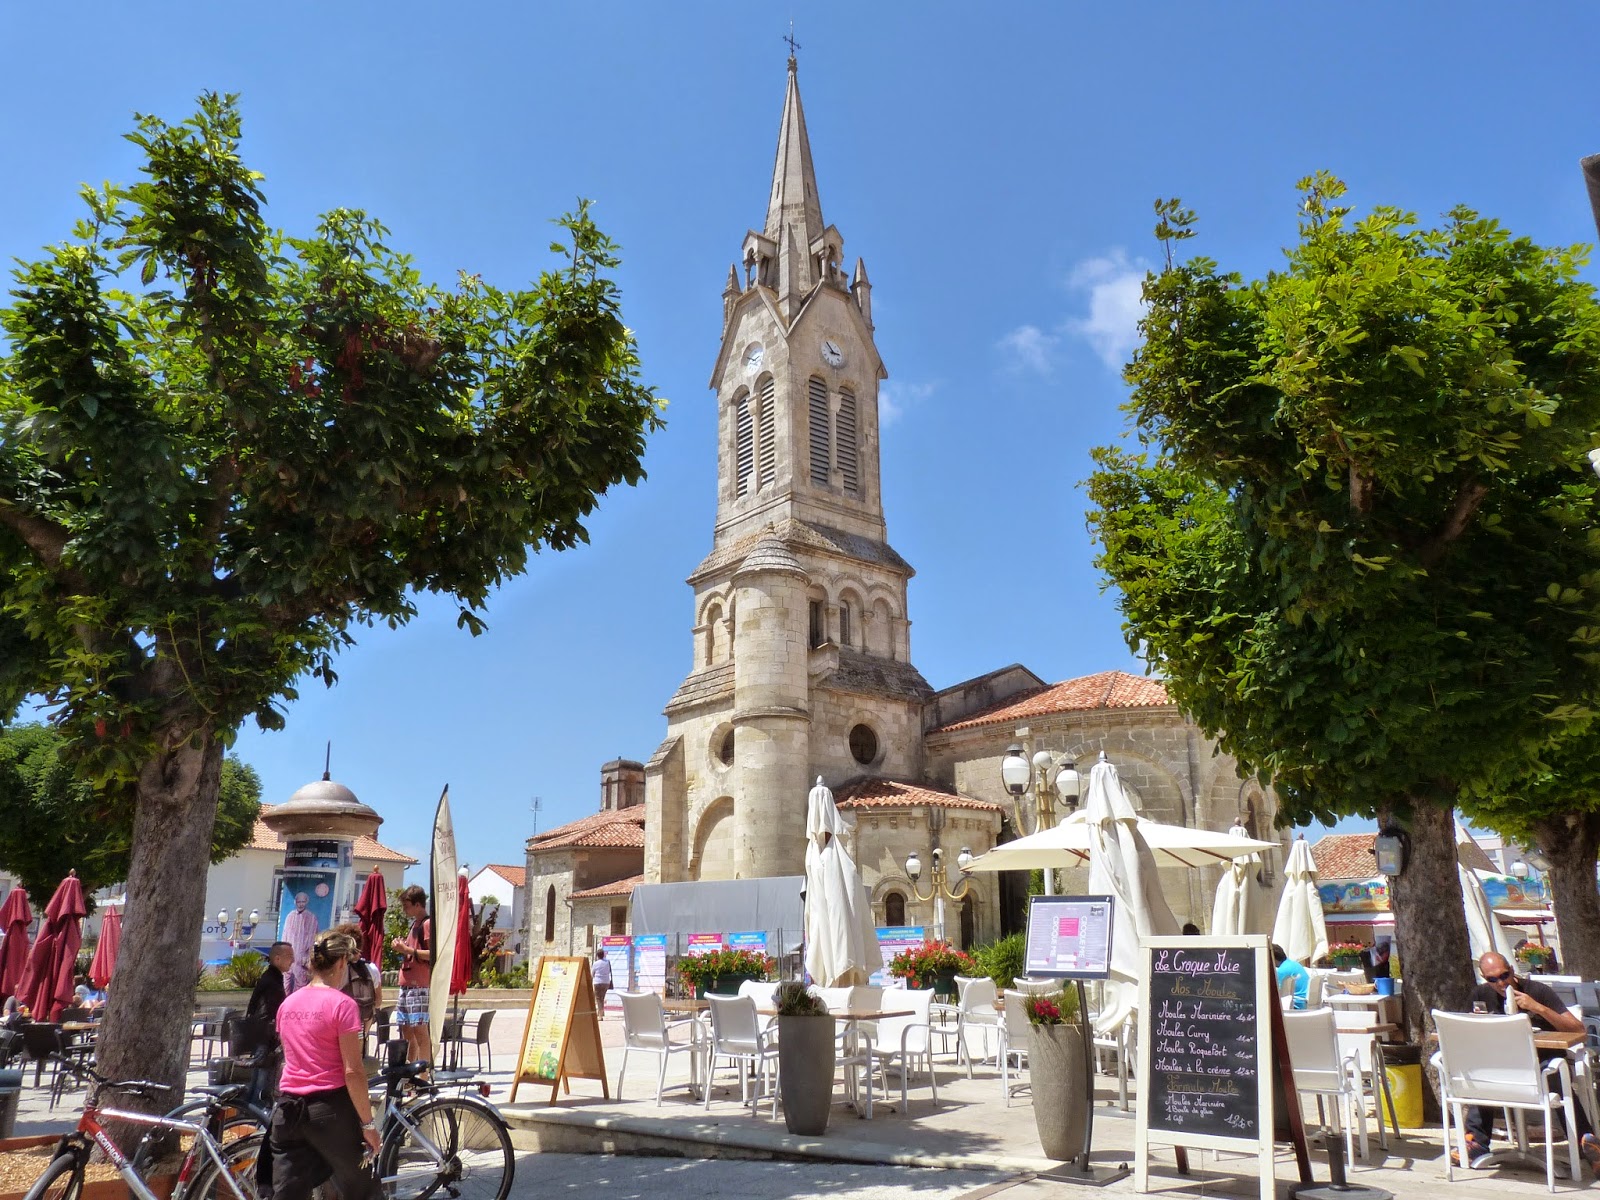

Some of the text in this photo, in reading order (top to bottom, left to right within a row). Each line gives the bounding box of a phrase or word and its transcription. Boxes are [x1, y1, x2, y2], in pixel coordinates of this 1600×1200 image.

[1155, 950, 1240, 977] Le Croque Mie
[1170, 976, 1237, 997] Nos Moules
[1158, 999, 1186, 1019] Moules
[1156, 1019, 1185, 1037] Moules
[1187, 1024, 1210, 1043] Curry
[1156, 1038, 1185, 1054] Moules
[1188, 1041, 1228, 1058] Roquefort
[1155, 1056, 1183, 1072] Moules
[1195, 1058, 1205, 1074] la
[1164, 1093, 1191, 1106] Moules
